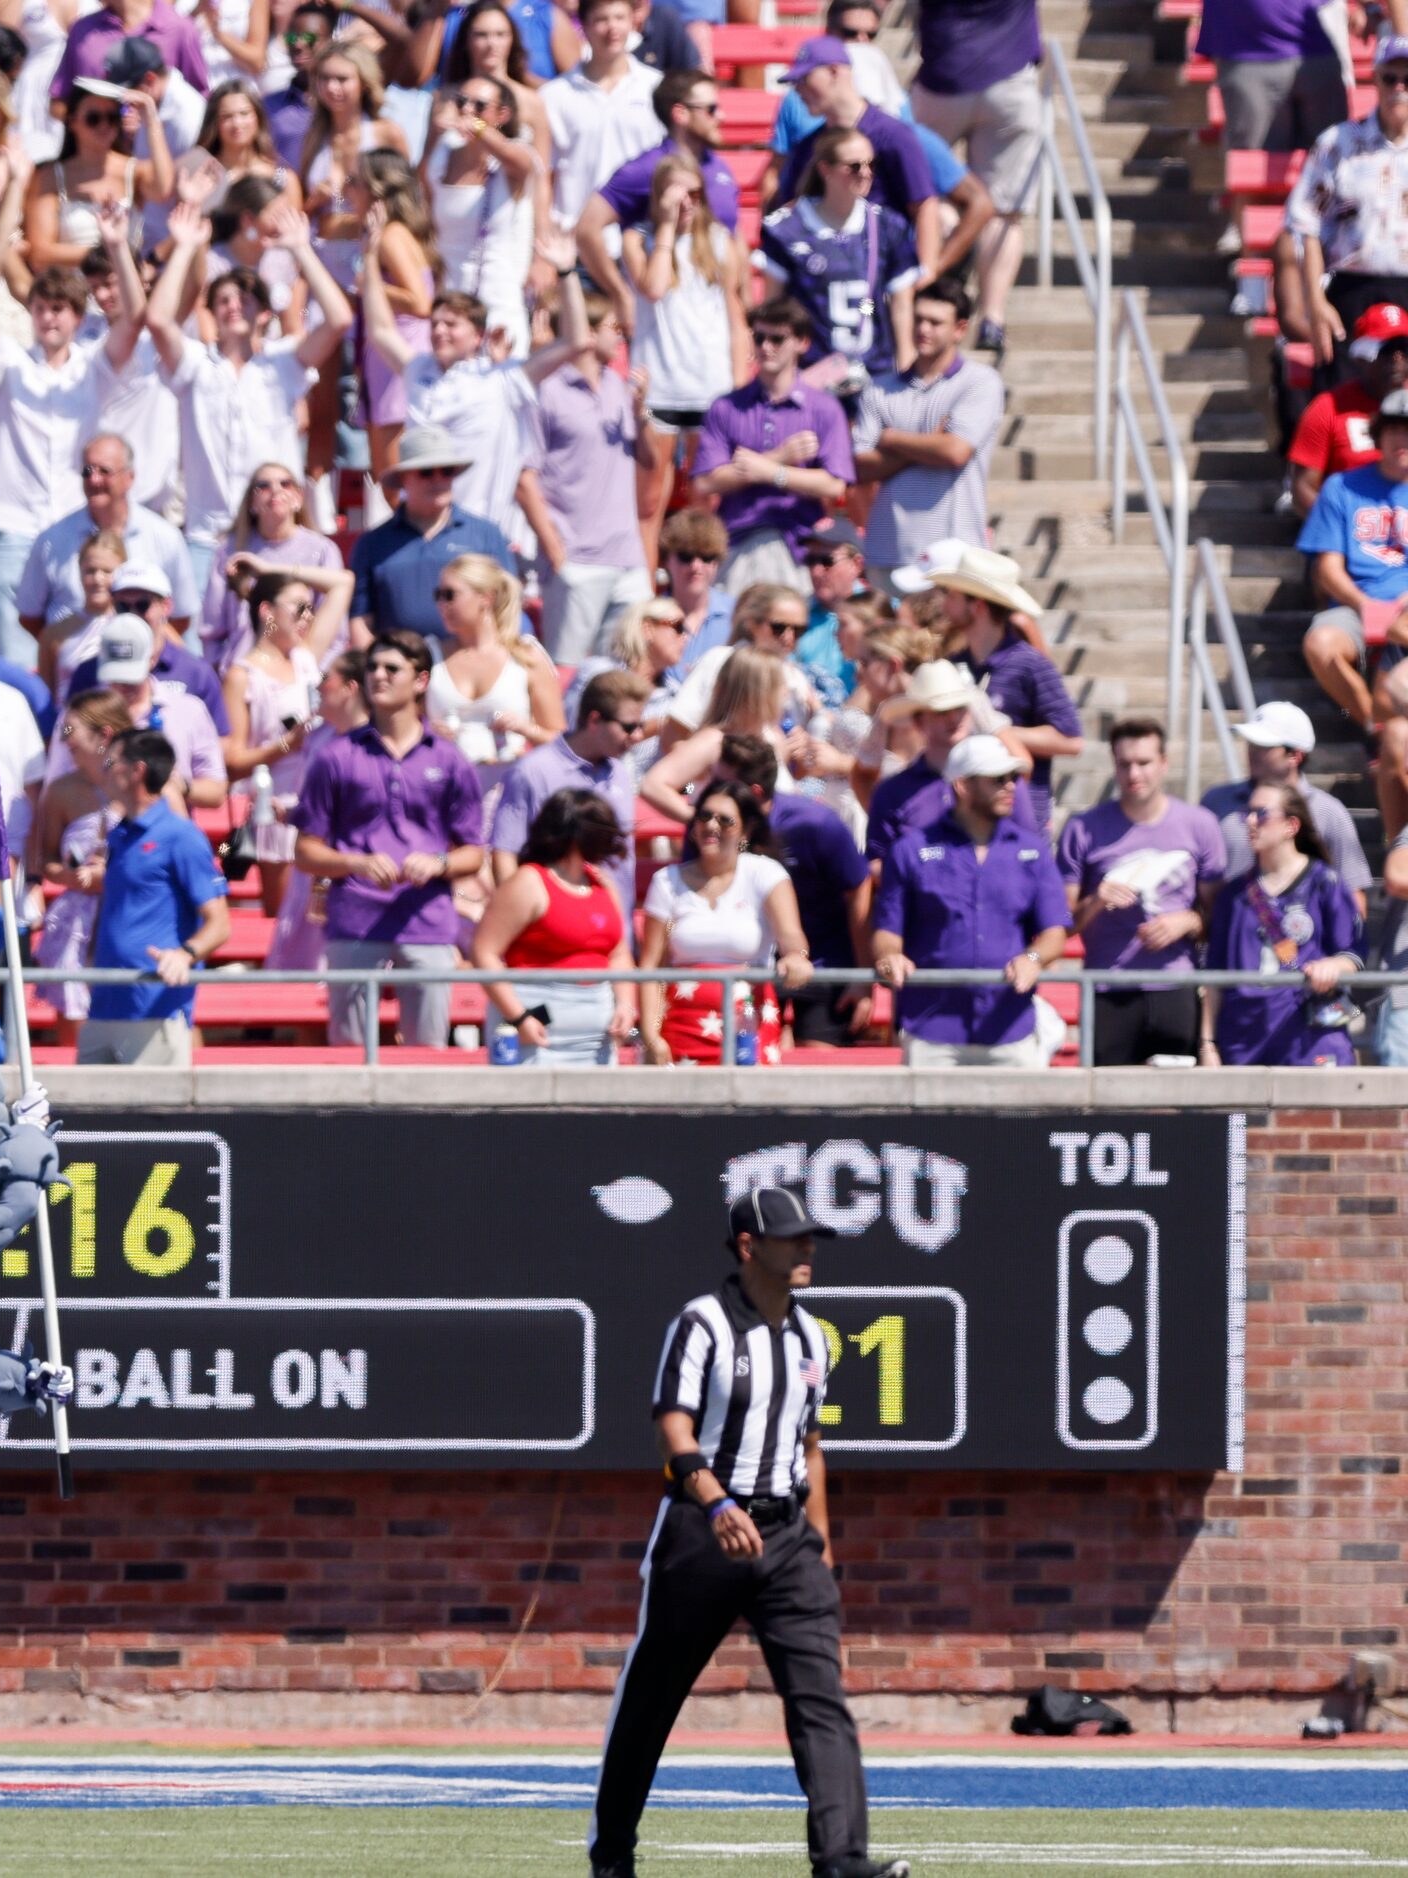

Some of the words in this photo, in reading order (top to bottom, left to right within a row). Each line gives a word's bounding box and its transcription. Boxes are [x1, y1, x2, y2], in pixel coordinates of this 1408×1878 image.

[828, 280, 874, 355] 5
[1049, 1132, 1169, 1186] TOL
[76, 1348, 255, 1410] BALL
[271, 1348, 368, 1410] ON
